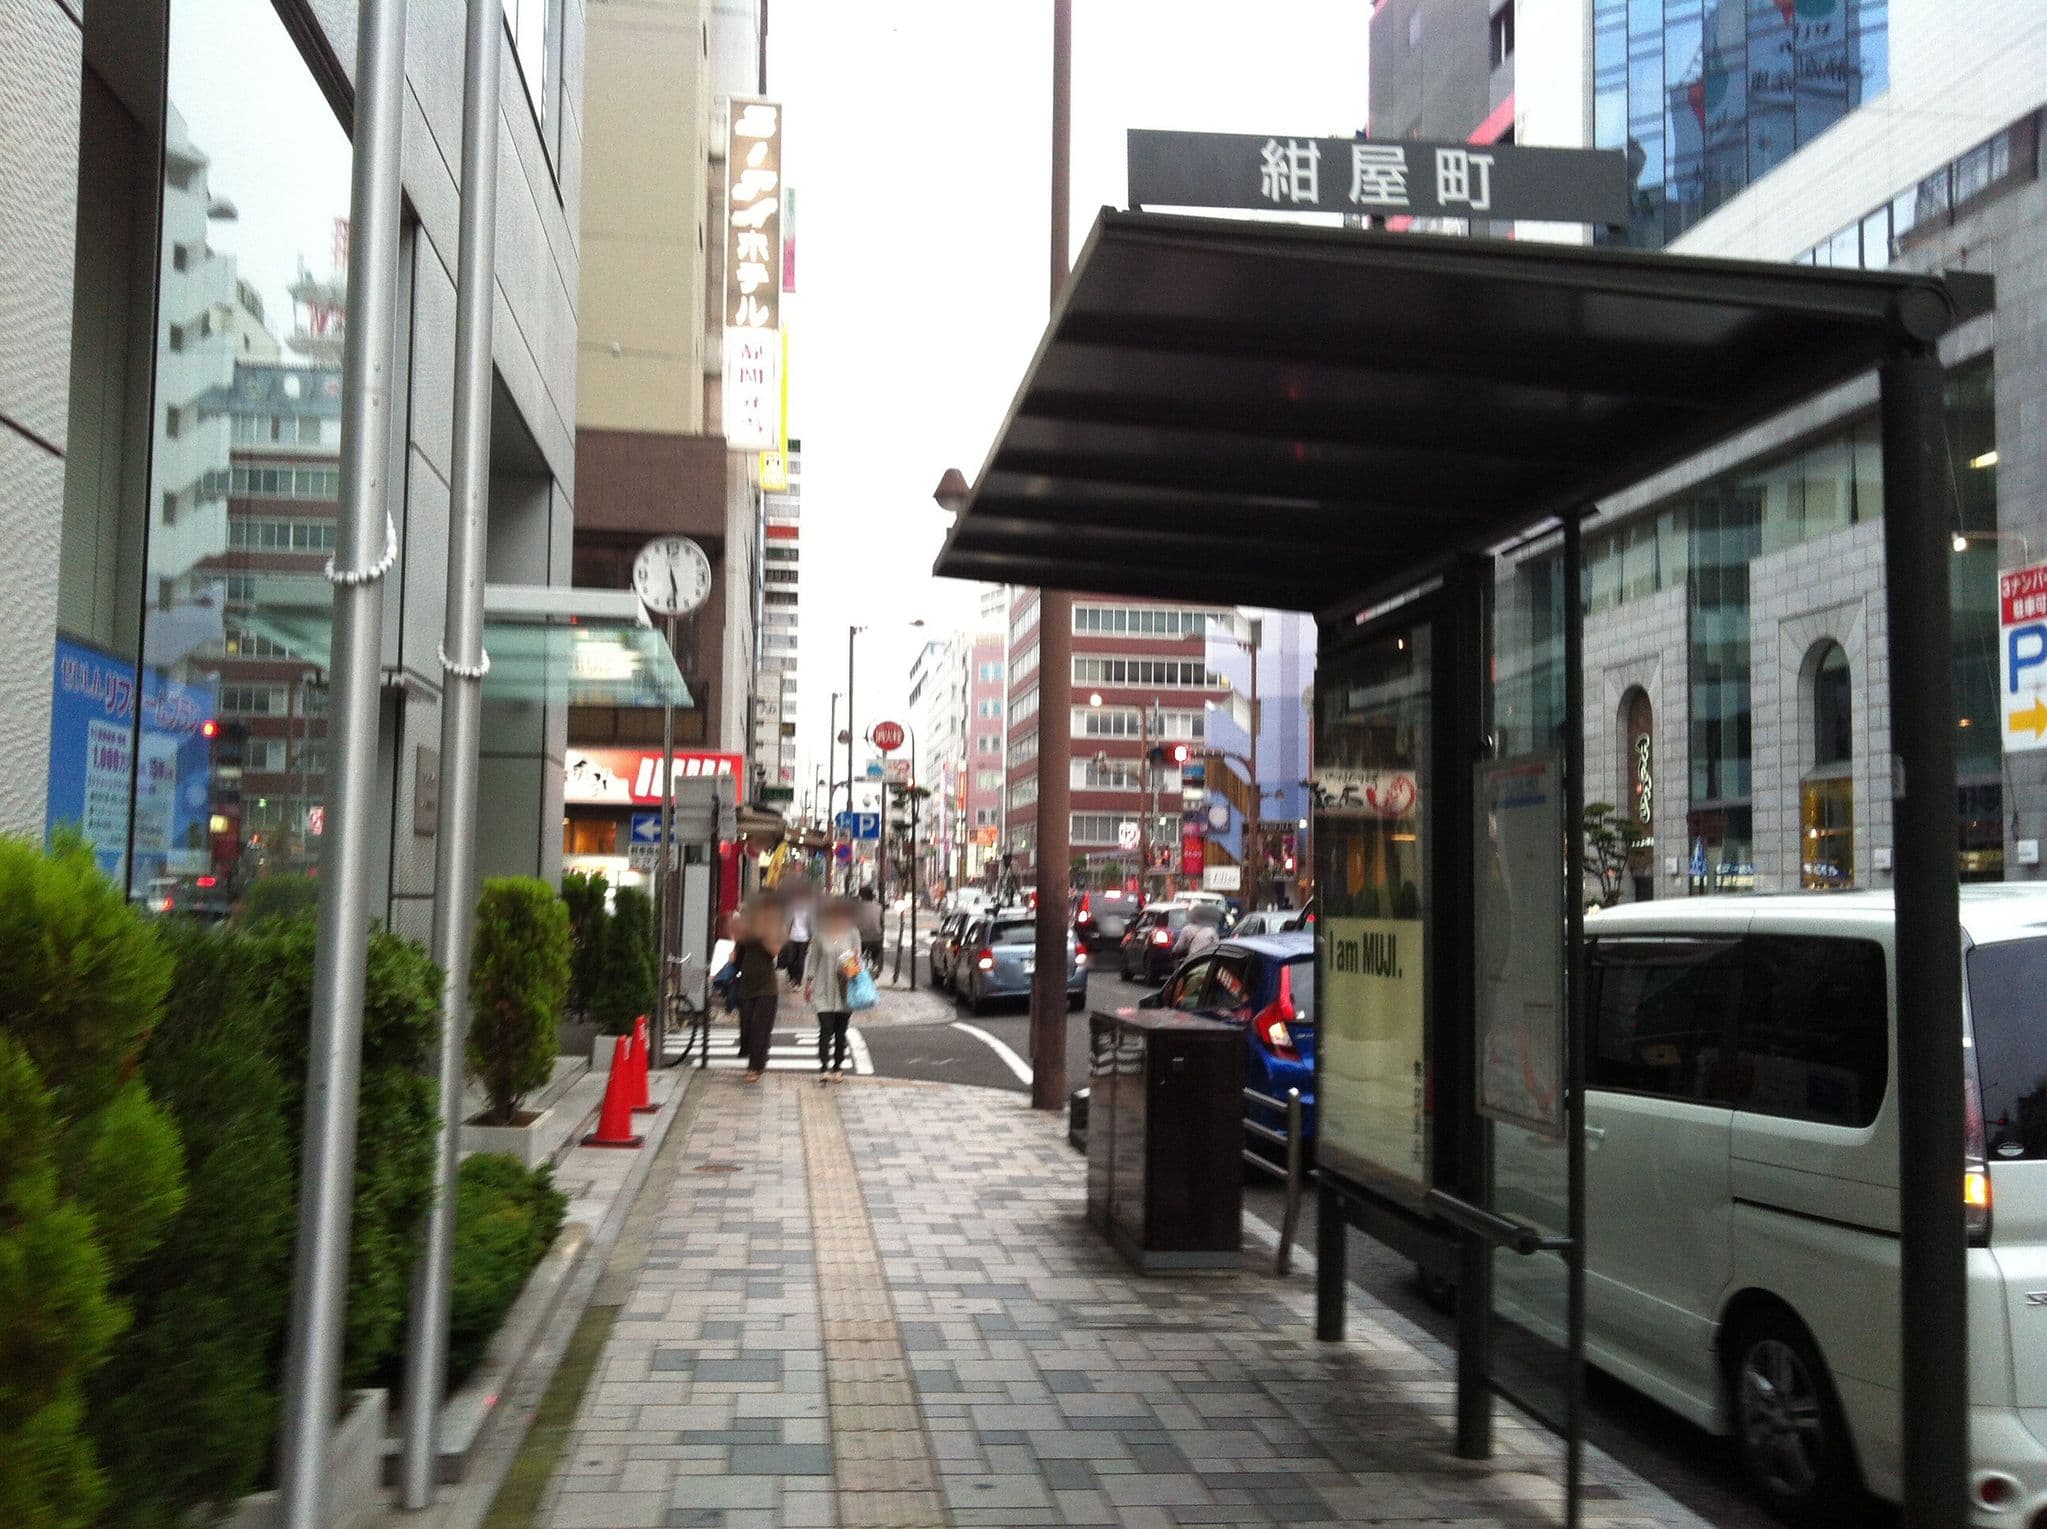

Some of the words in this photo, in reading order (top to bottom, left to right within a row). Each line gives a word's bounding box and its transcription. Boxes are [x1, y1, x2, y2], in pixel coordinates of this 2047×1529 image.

[1259, 137, 1495, 211] 紺屋町
[2008, 622, 2047, 694] P
[859, 813, 876, 838] P
[1328, 930, 1334, 971] I
[1336, 940, 1359, 974] am
[1362, 931, 1403, 979] MUJI.
